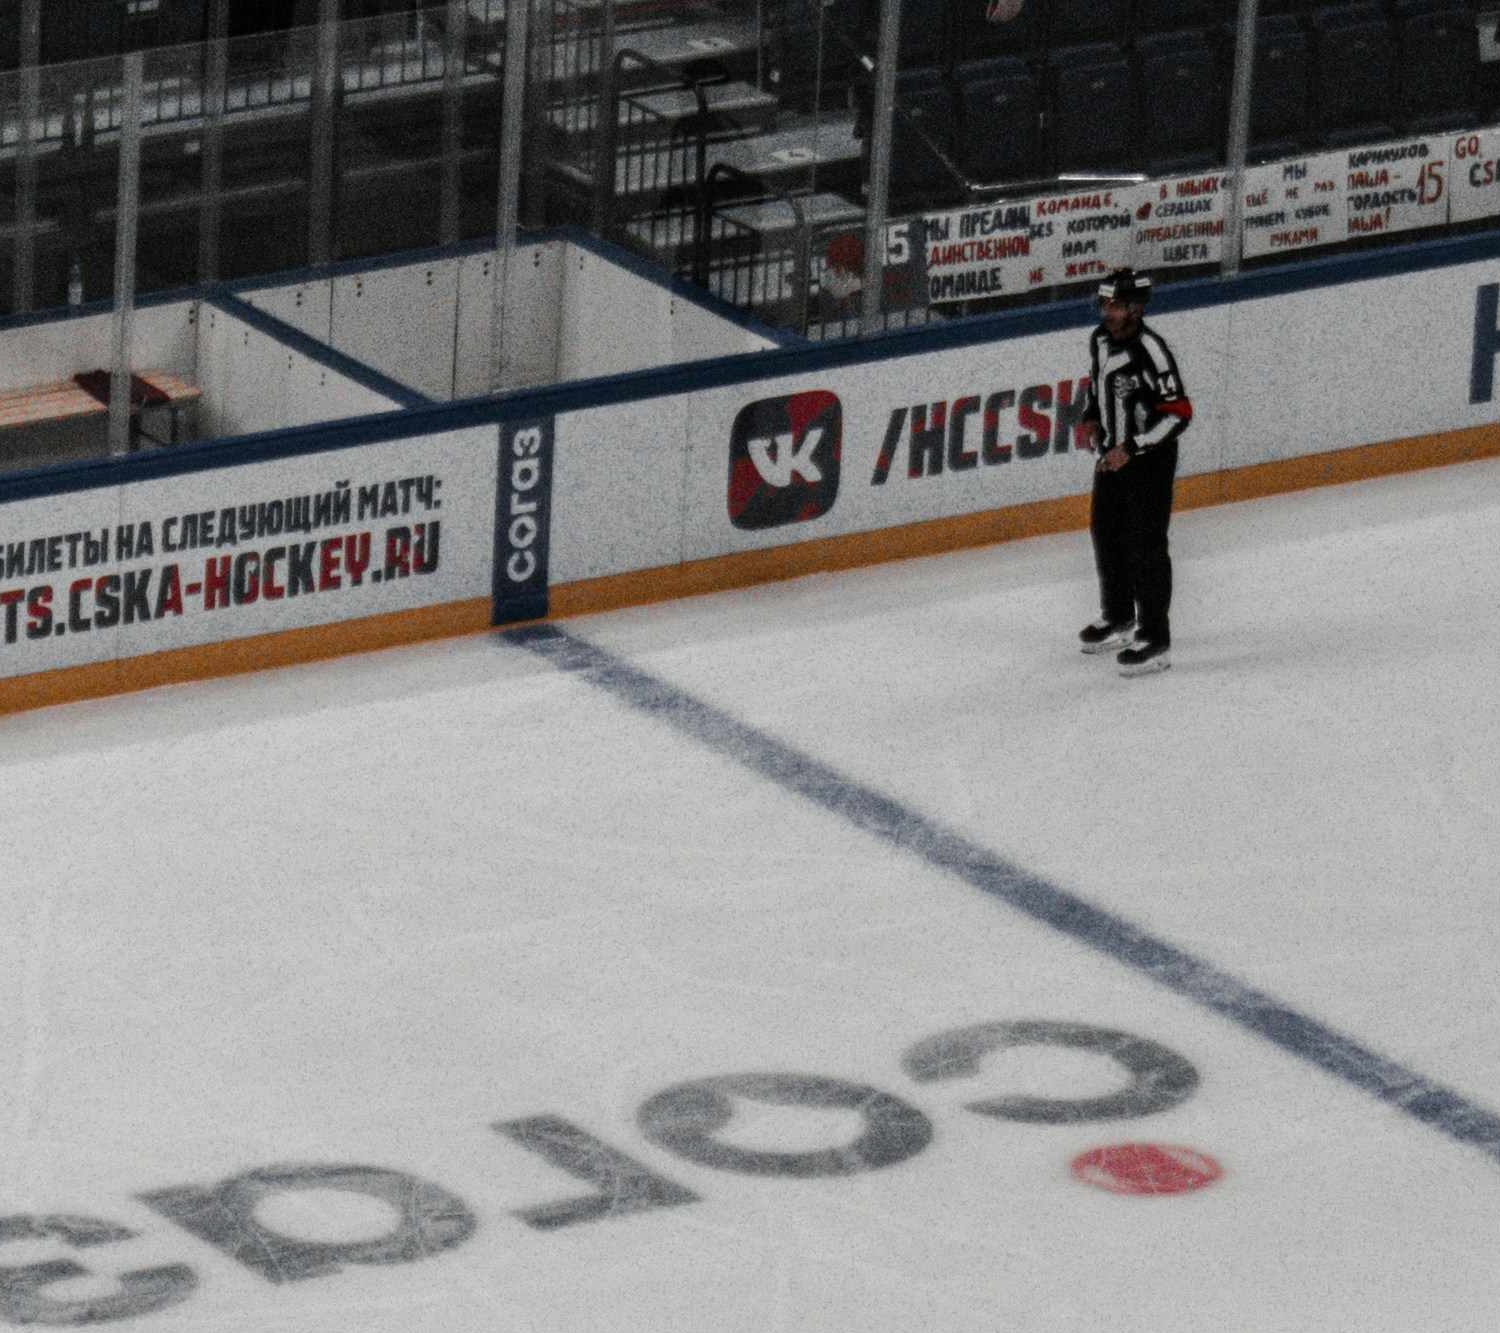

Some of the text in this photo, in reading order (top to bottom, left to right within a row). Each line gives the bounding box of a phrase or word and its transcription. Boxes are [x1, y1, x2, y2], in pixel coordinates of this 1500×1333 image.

[1416, 160, 1445, 206] 15
[930, 267, 1003, 299] ОМАНДЕ
[871, 376, 1092, 487] /HCCSK
[116, 522, 155, 562] НА
[161, 481, 352, 554] СЛЕДУЮЩИЙ
[357, 473, 443, 522] МАТЧ:
